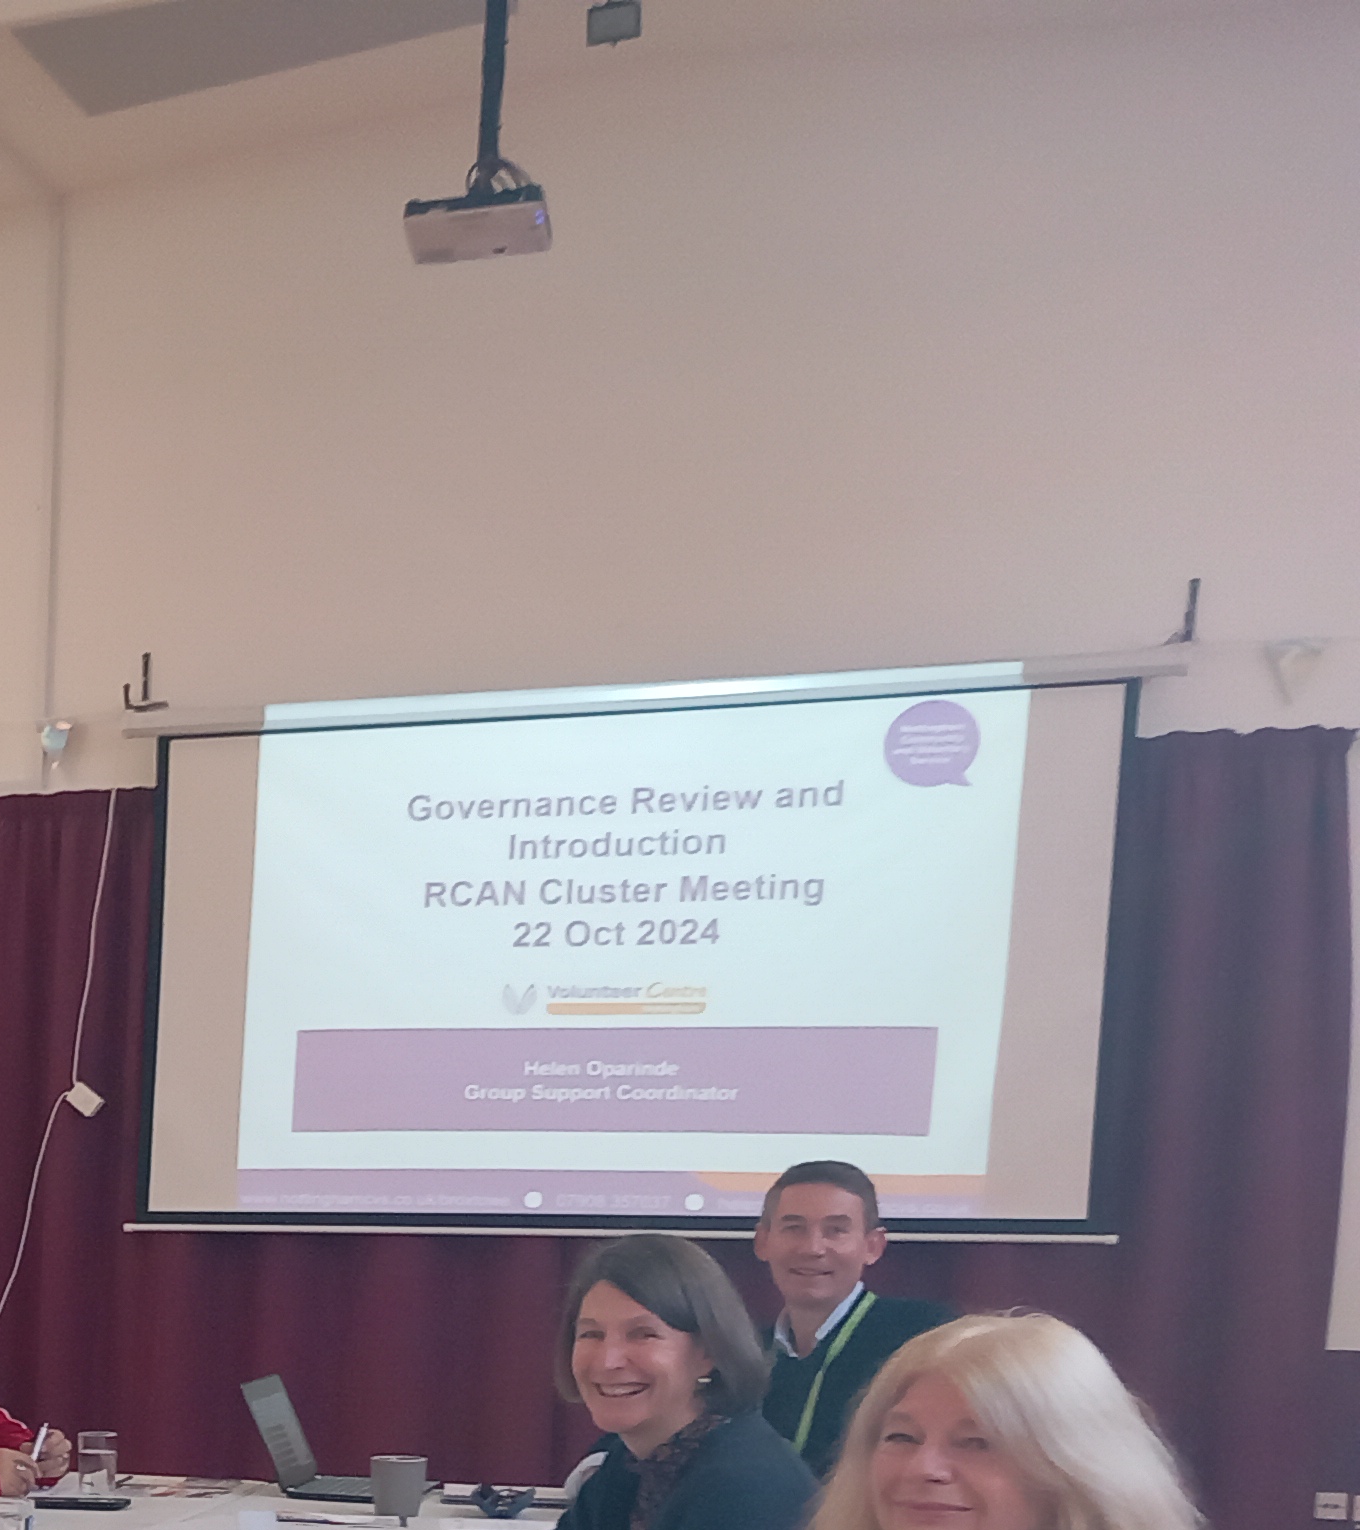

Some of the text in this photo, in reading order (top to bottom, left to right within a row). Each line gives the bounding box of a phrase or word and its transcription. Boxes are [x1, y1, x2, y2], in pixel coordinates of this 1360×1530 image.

[407, 780, 845, 822] Governance Review and
[508, 829, 727, 860] Introduction
[424, 873, 825, 908] RCAN Cluster Meeting
[512, 917, 721, 948] 22 Oct 2024
[524, 1060, 581, 1076] Helen
[463, 1083, 740, 1103] Group Support Coordinator
